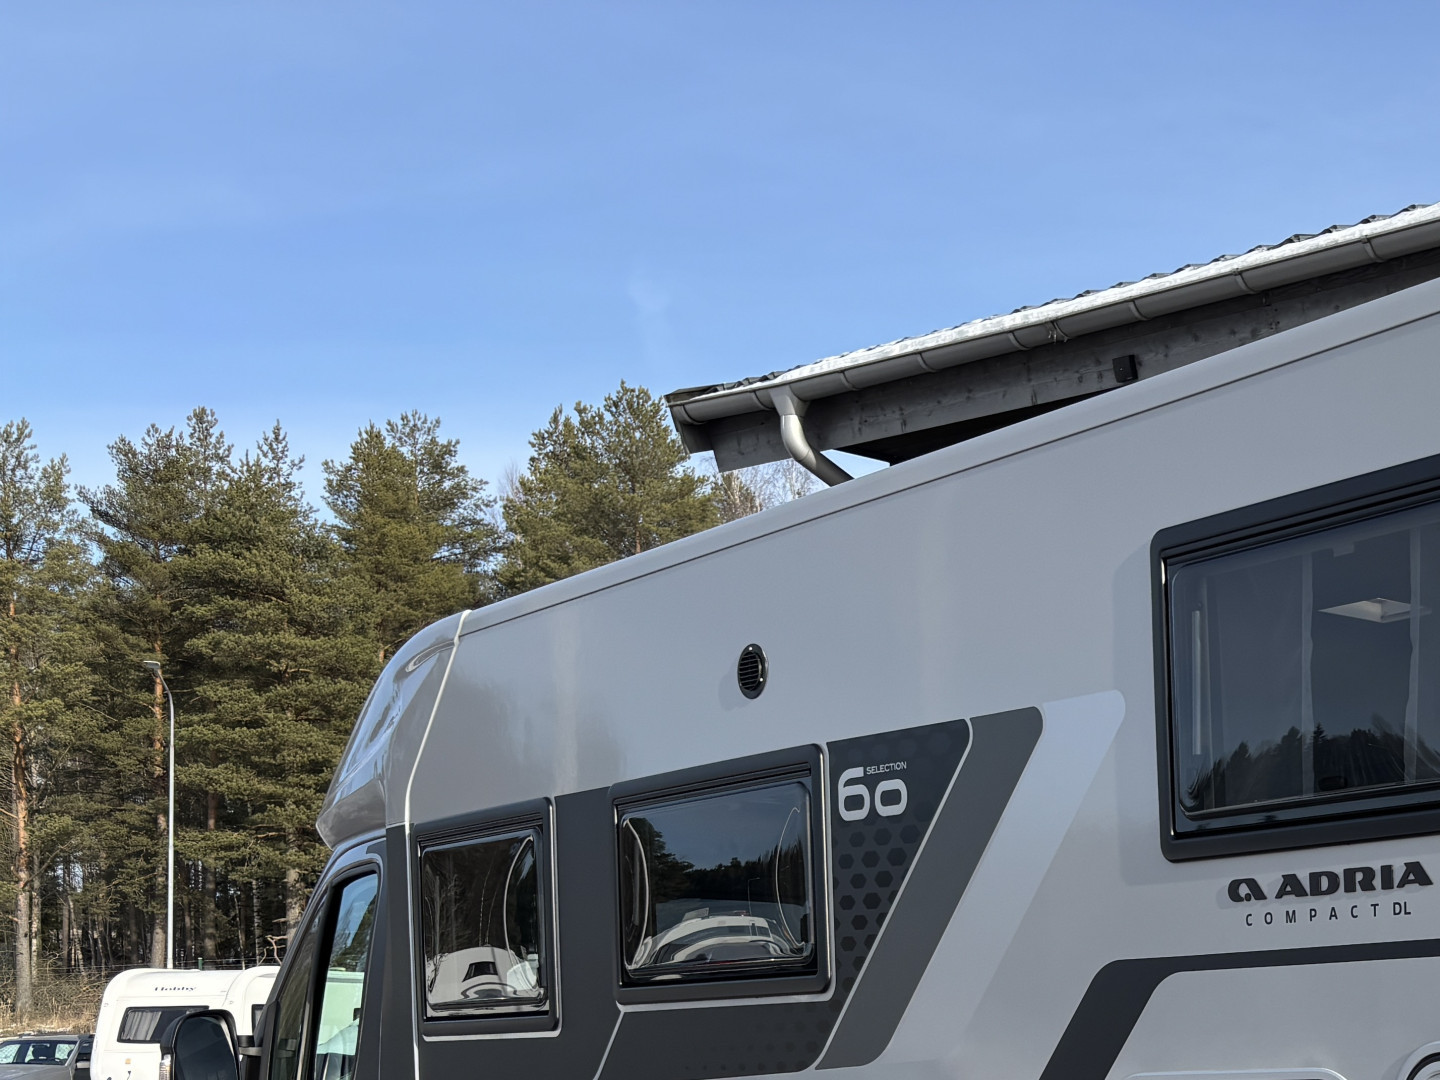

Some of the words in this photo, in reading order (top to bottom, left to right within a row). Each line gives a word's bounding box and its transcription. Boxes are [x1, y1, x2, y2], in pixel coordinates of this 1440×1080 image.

[866, 761, 907, 775] SELECTION
[838, 766, 908, 822] 60
[1274, 861, 1434, 900] ADRIA
[1245, 903, 1380, 927] COMPACT
[1392, 901, 1412, 916] DL
